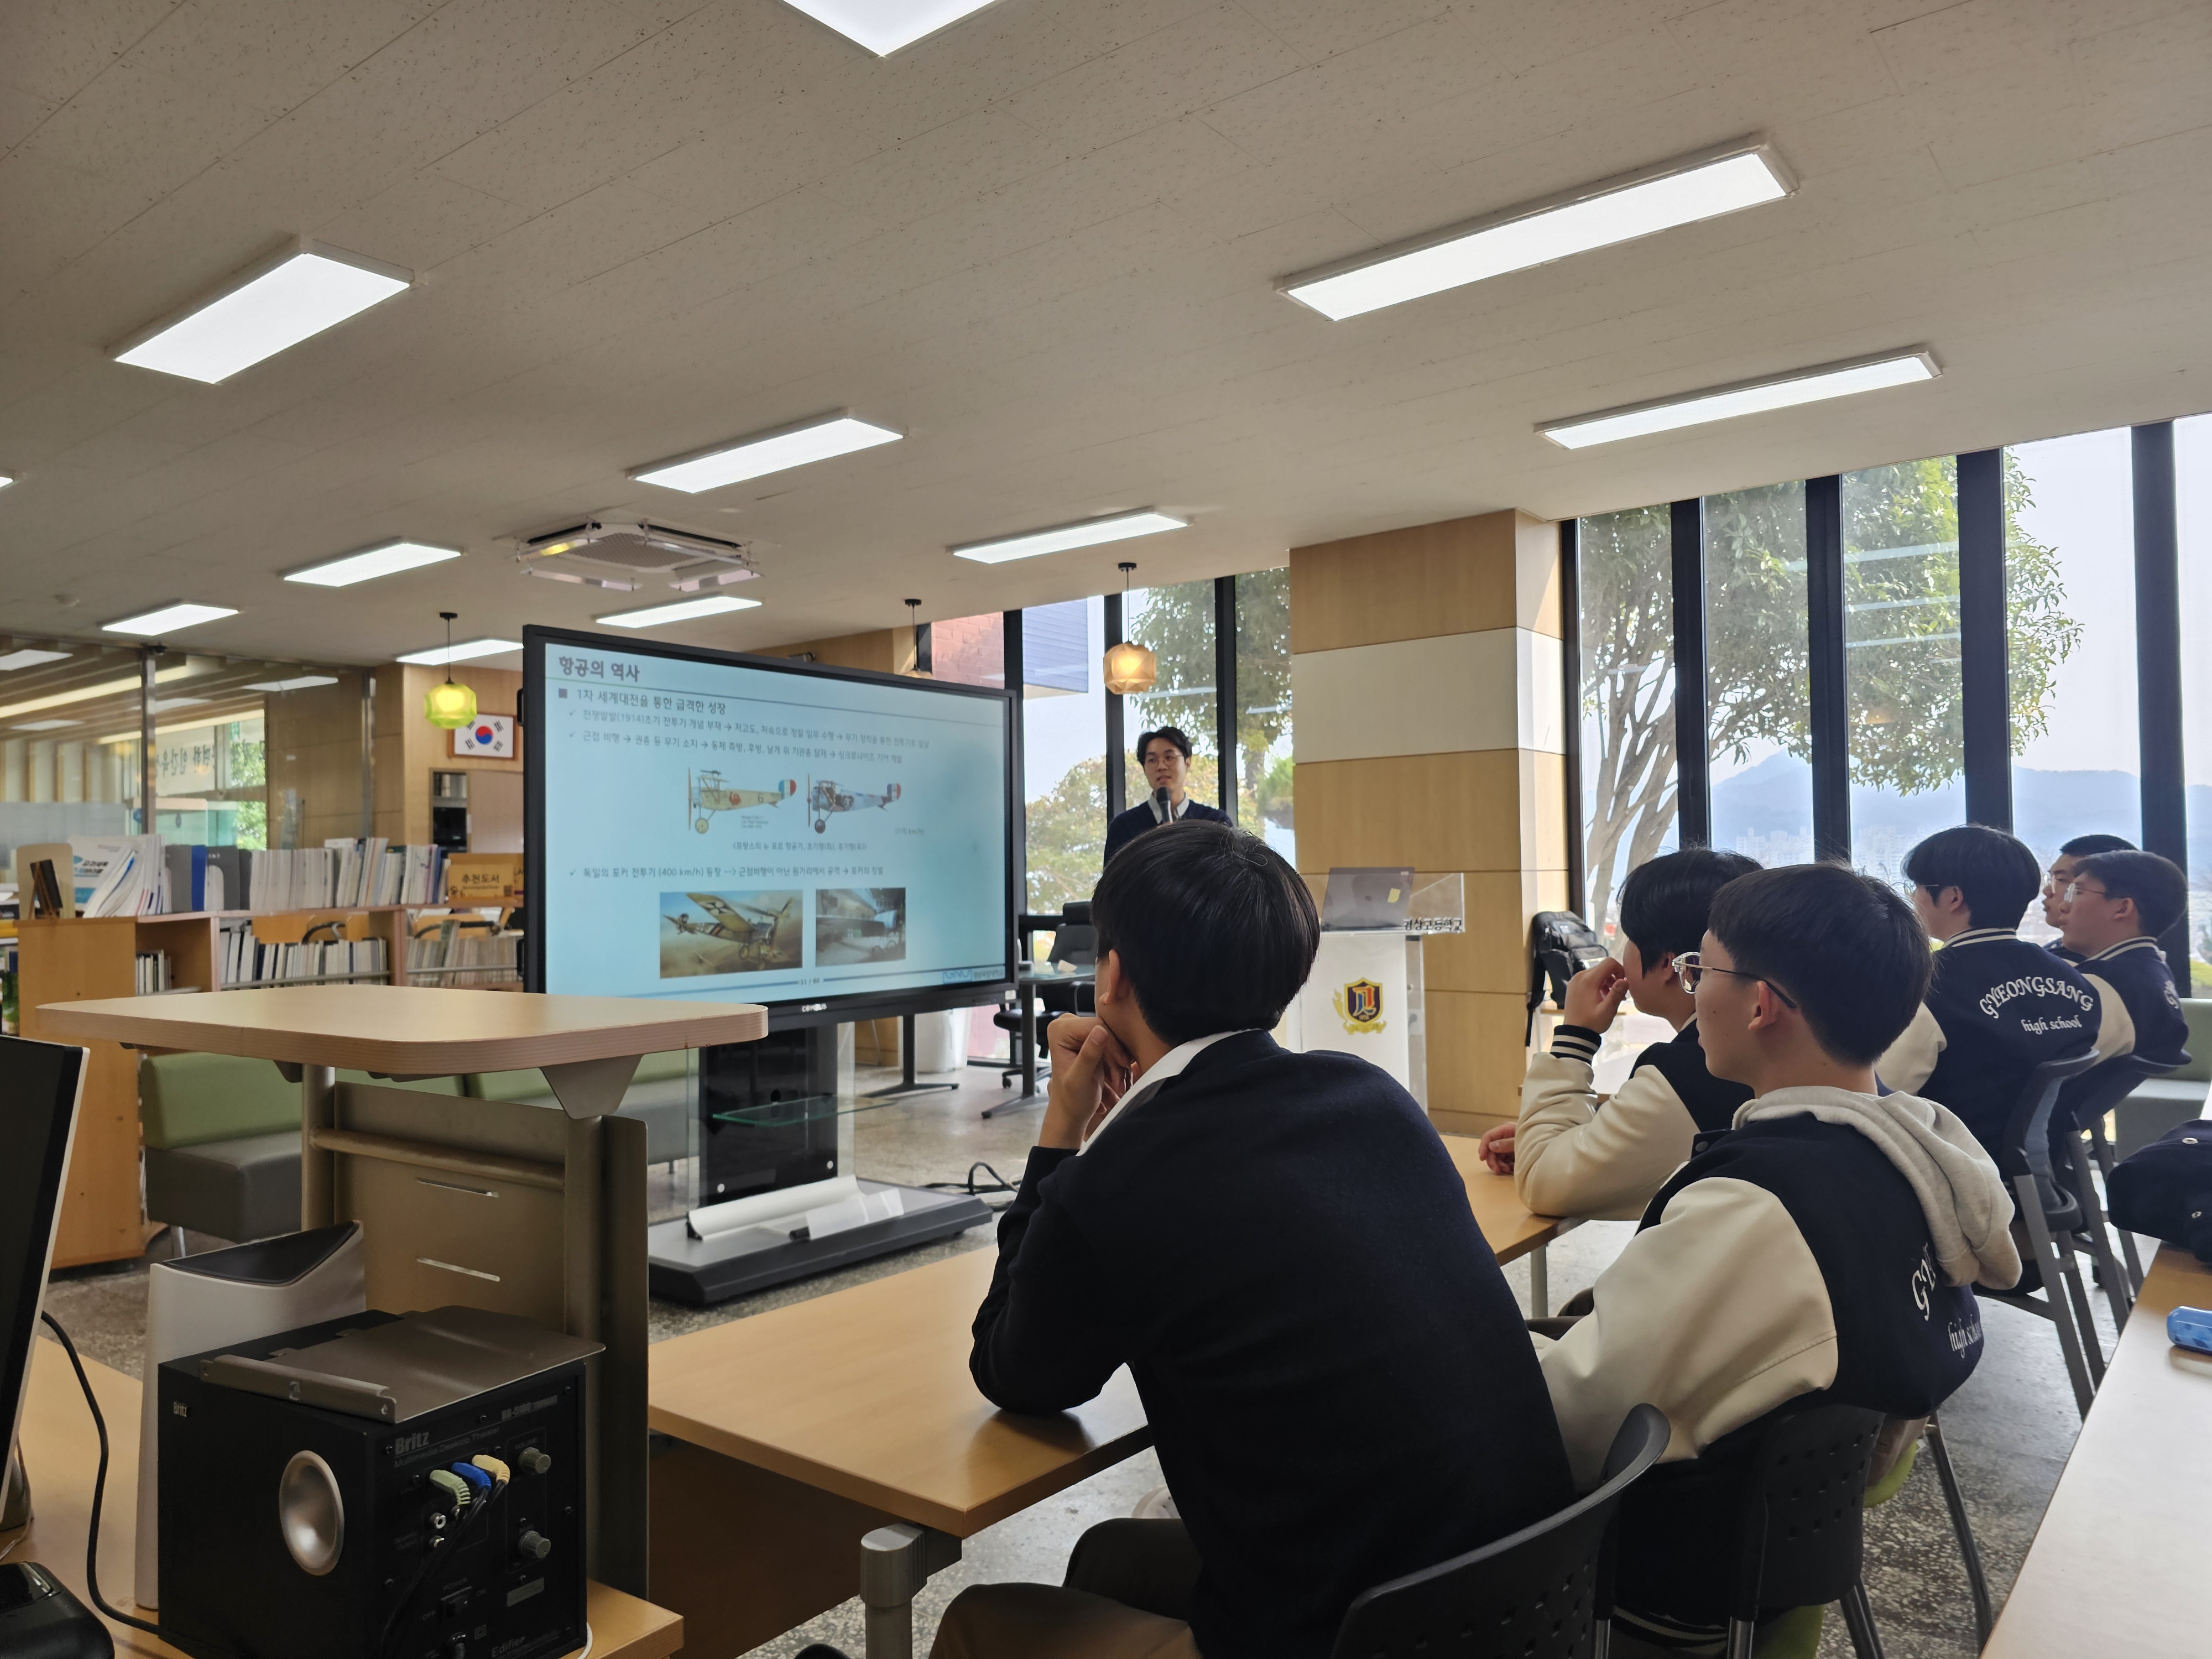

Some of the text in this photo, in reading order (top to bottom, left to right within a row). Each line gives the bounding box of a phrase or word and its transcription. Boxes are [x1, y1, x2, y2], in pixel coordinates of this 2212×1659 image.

[559, 656, 640, 682] 항공의 역사
[577, 689, 726, 715] 1차 세계대전을 통한 급격한 성장
[664, 717, 686, 728] 전투기
[689, 718, 704, 729] 개념
[707, 720, 722, 731] 부재
[761, 725, 789, 736] 저속으로
[583, 731, 600, 742] 근접
[603, 732, 619, 743] 비행
[665, 737, 680, 747] 무기
[682, 738, 698, 748] 소지
[462, 873, 499, 884] 추천도서
[583, 867, 609, 878] 독일의
[612, 867, 628, 878] 포커
[633, 867, 656, 878] 전투기
[658, 867, 677, 878] (400
[680, 867, 705, 878] km/h)
[707, 867, 721, 878] 등장
[776, 867, 790, 877] 아닌
[792, 867, 825, 877] 원거리에서
[828, 866, 841, 876] 공격
[1403, 917, 1462, 932] 경상고등학교
[1979, 976, 2093, 1019] GYEONGSANG
[2021, 1015, 2083, 1035] high school
[1948, 1318, 1968, 1359] high
[174, 1401, 187, 1417] Britz
[395, 1432, 429, 1455] Britz
[471, 1427, 500, 1441] Theater
[444, 1577, 468, 1591] POWER
[492, 1636, 525, 1657] Edifier
